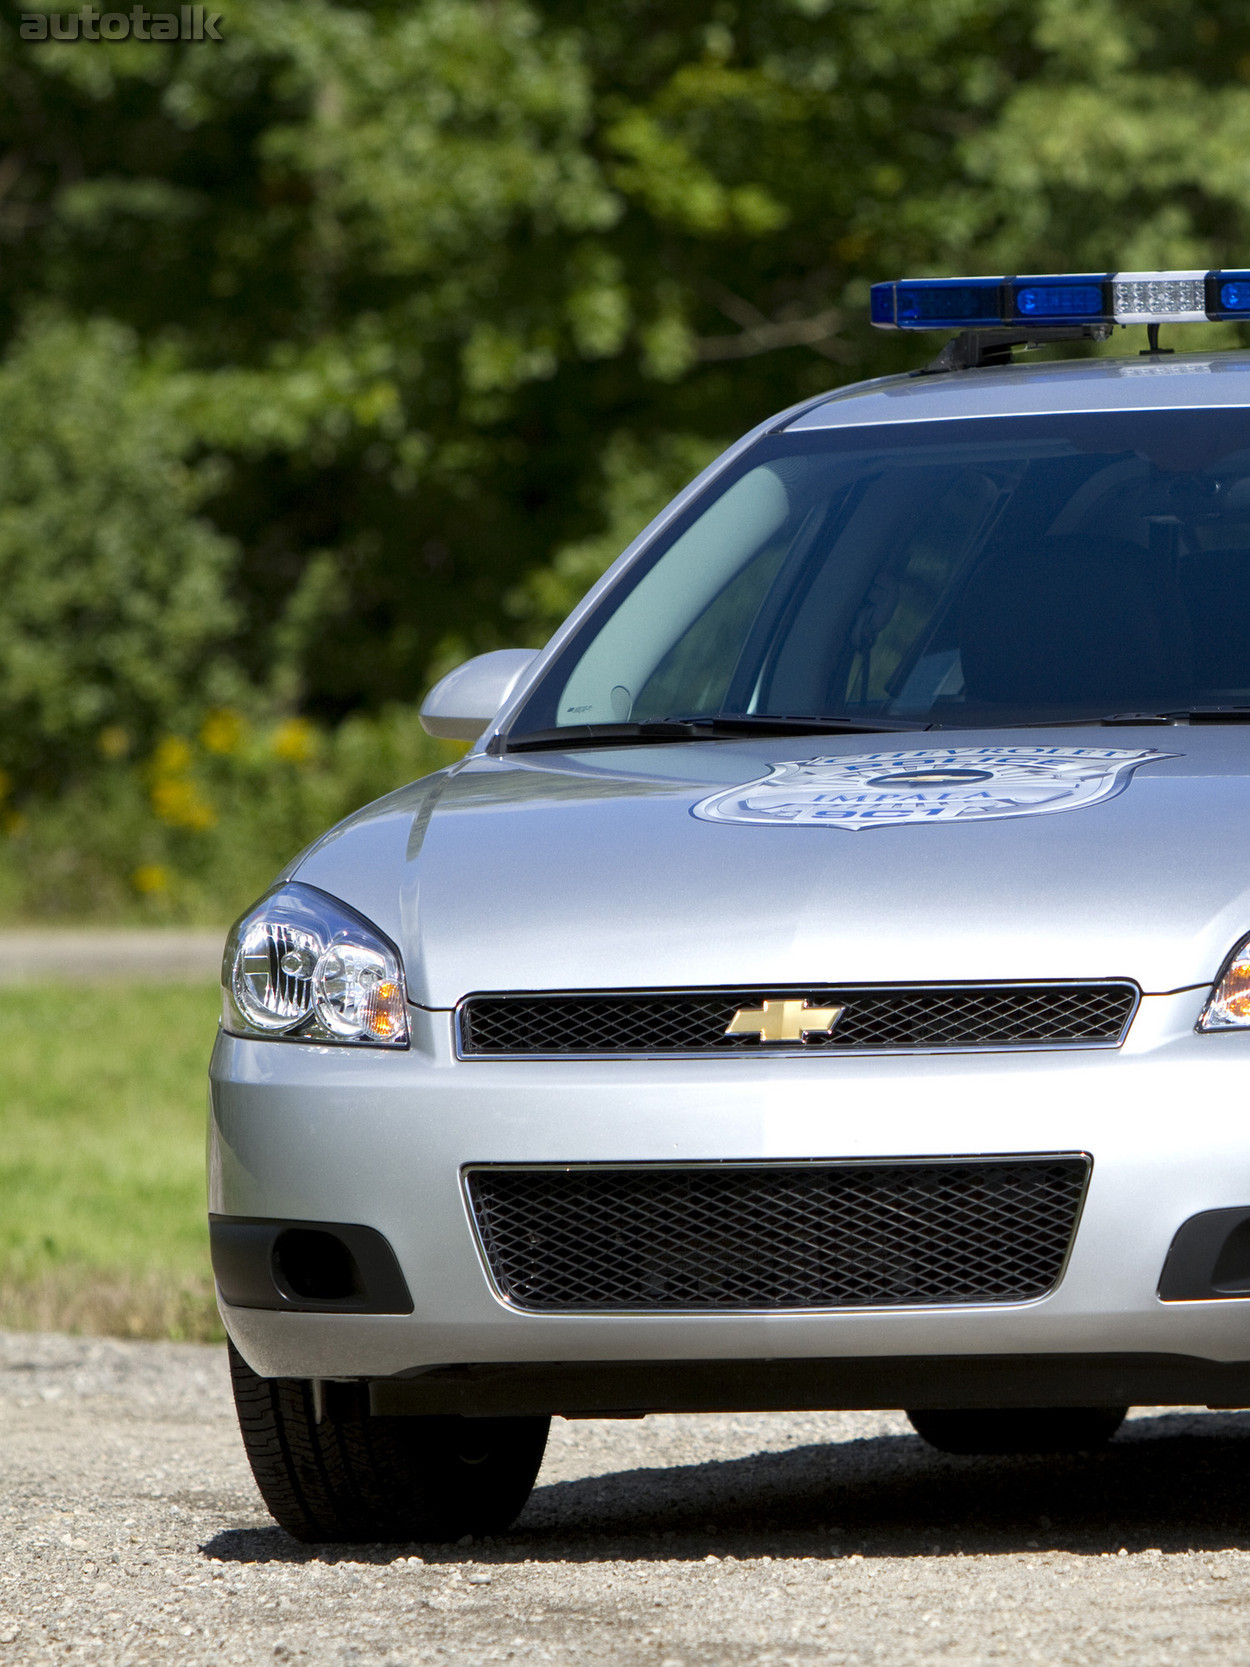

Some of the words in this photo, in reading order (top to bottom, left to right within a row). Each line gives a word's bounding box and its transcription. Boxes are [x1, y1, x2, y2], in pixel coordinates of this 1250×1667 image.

[823, 747, 1128, 764] CHEVROLET
[843, 757, 1077, 771] POLICE
[812, 791, 992, 803] IMPALA
[811, 808, 945, 819] 9C1
